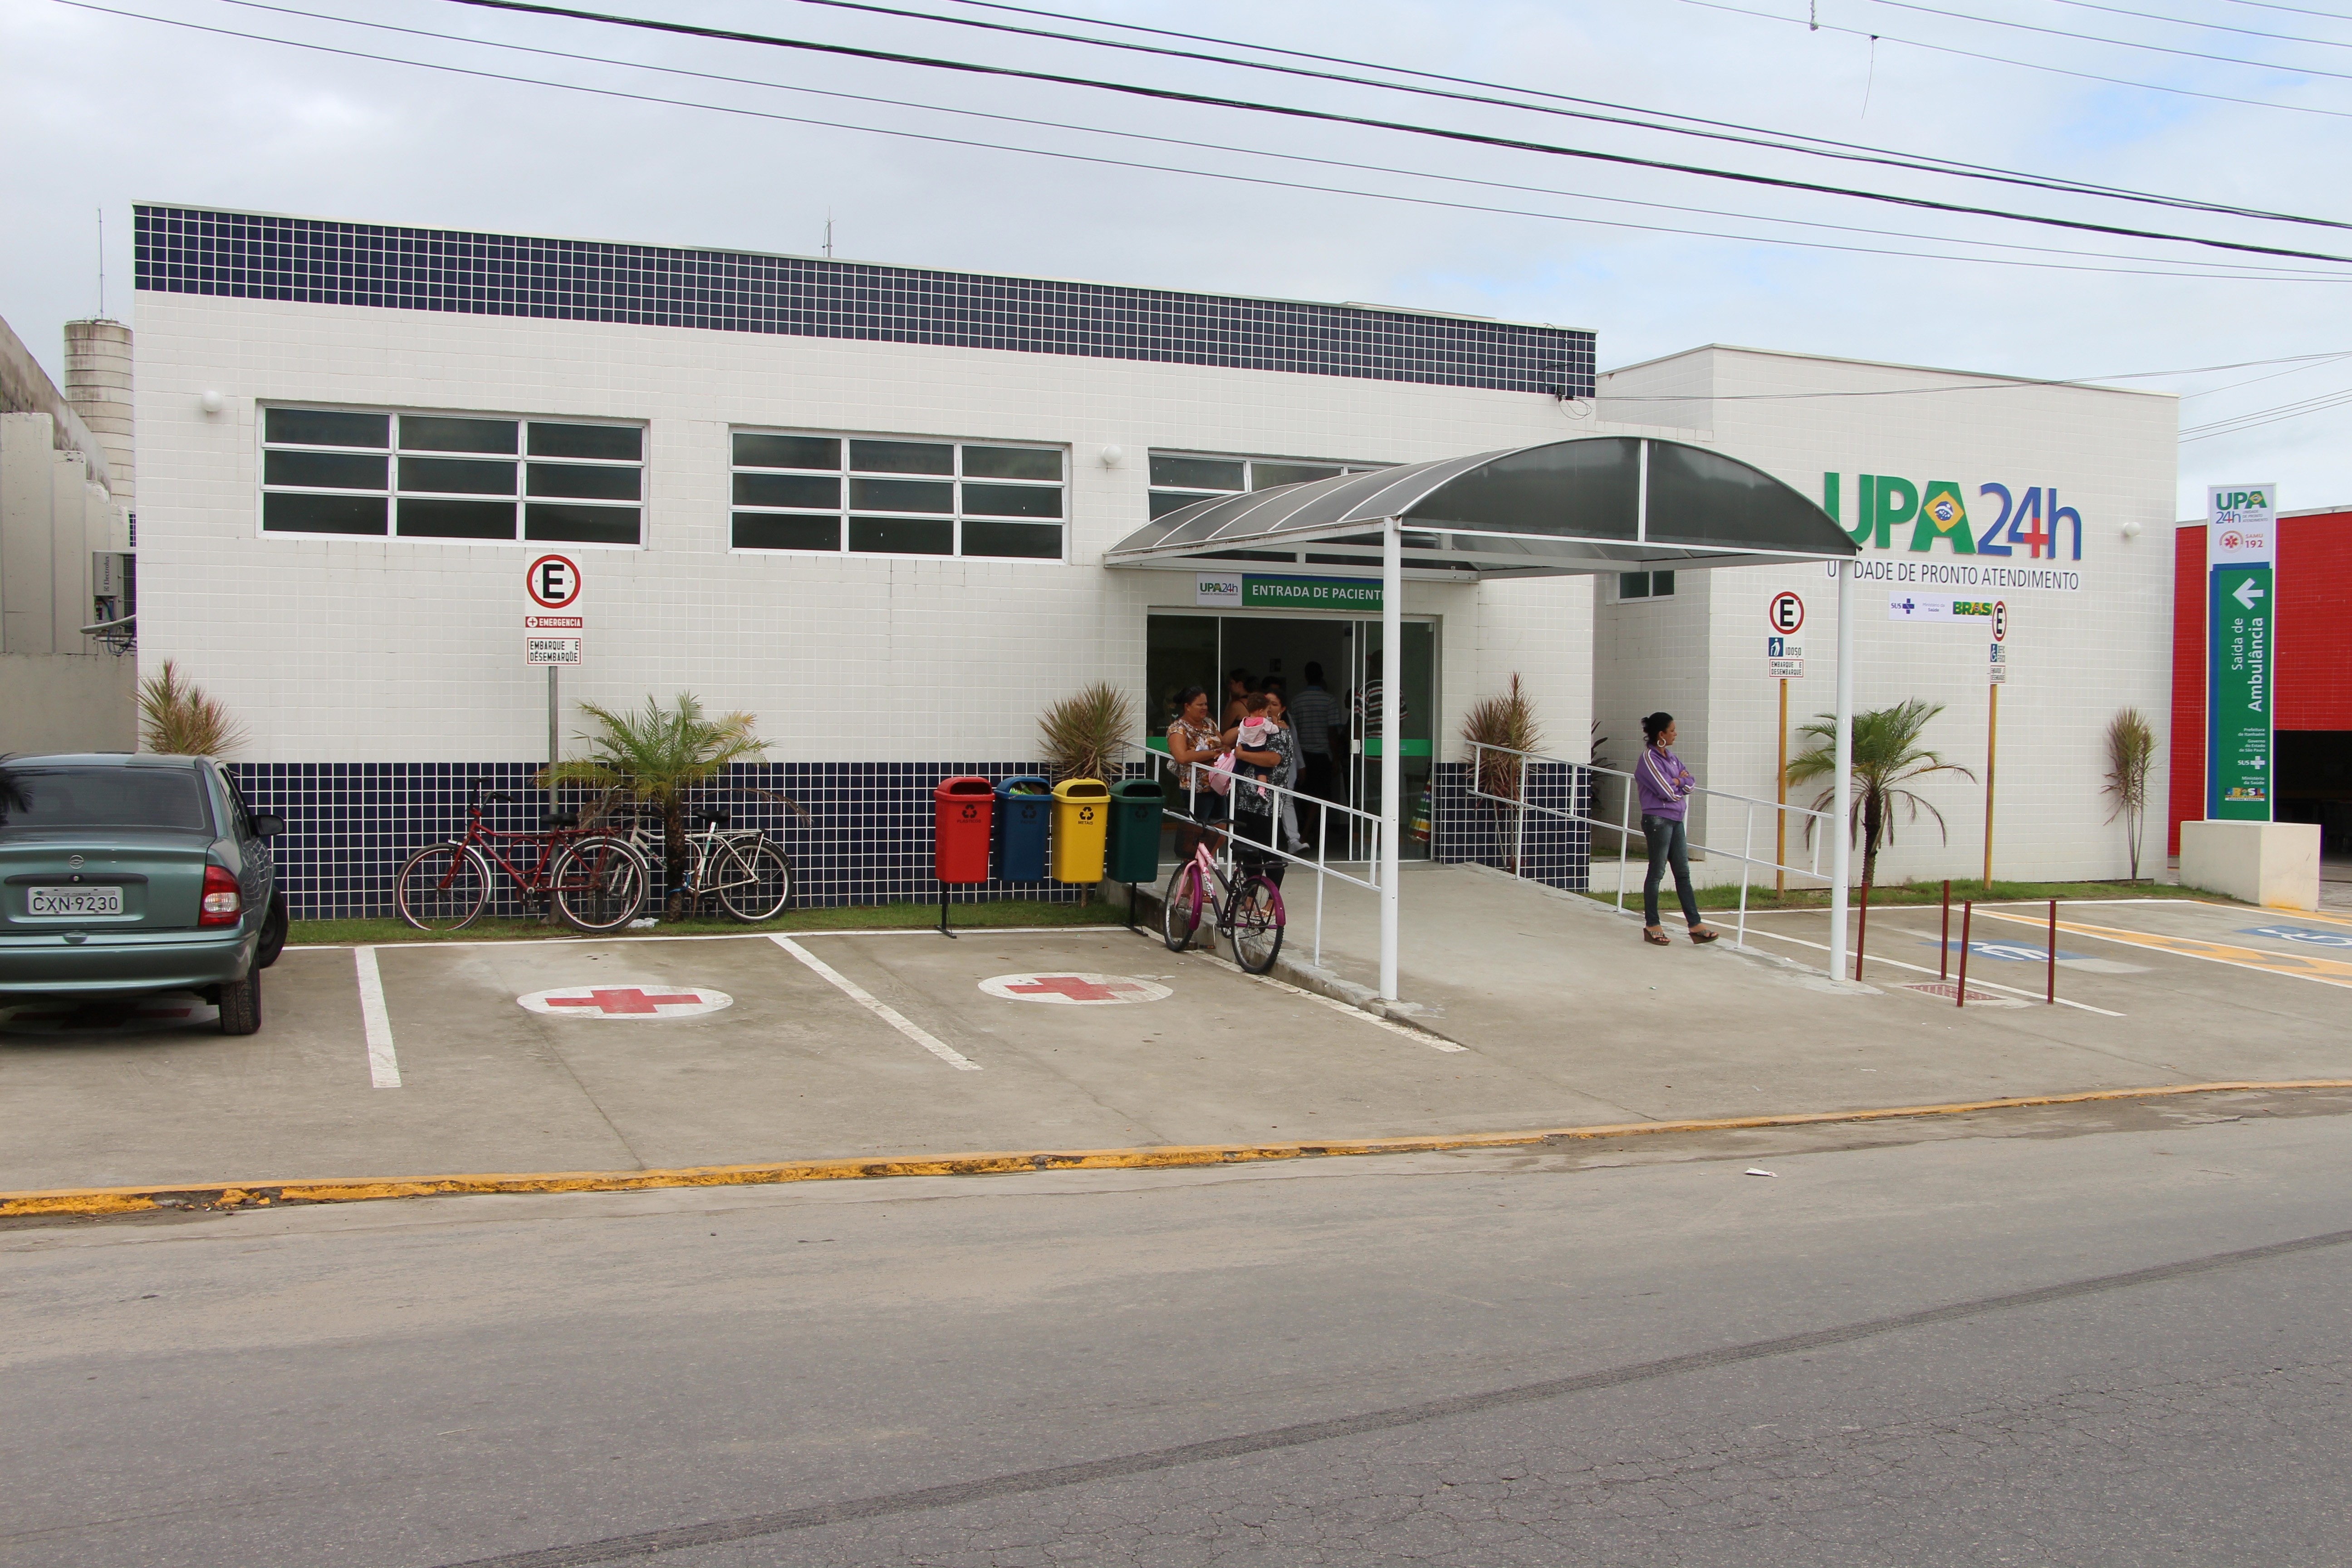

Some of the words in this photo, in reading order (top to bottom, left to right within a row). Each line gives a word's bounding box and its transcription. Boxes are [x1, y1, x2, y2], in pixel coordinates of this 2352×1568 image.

[2216, 491, 2267, 510] UPA
[2215, 511, 2241, 524] 24h
[2245, 540, 2264, 548] 192
[543, 564, 565, 599] E
[1827, 560, 1893, 580] UDADE
[1898, 563, 1916, 582] DE
[1922, 564, 1978, 585] PRONTO
[1981, 568, 2079, 590] ATENDIMENTO
[1252, 585, 1310, 597] ENTRADA
[1313, 587, 1328, 598] DE
[1333, 588, 1384, 600] PACIENT
[1780, 599, 1794, 627] E
[1953, 602, 1992, 616] BRAS
[539, 618, 581, 627] EMERGENCIA
[1996, 608, 2003, 634] E
[2231, 617, 2243, 633] de
[530, 641, 565, 651] EMBARQUE
[575, 641, 579, 650] E
[1785, 647, 1802, 656] IDOSO
[2231, 637, 2243, 670] Saída
[530, 652, 578, 662] DESEMBARQUE
[2247, 617, 2263, 712] Ambulância
